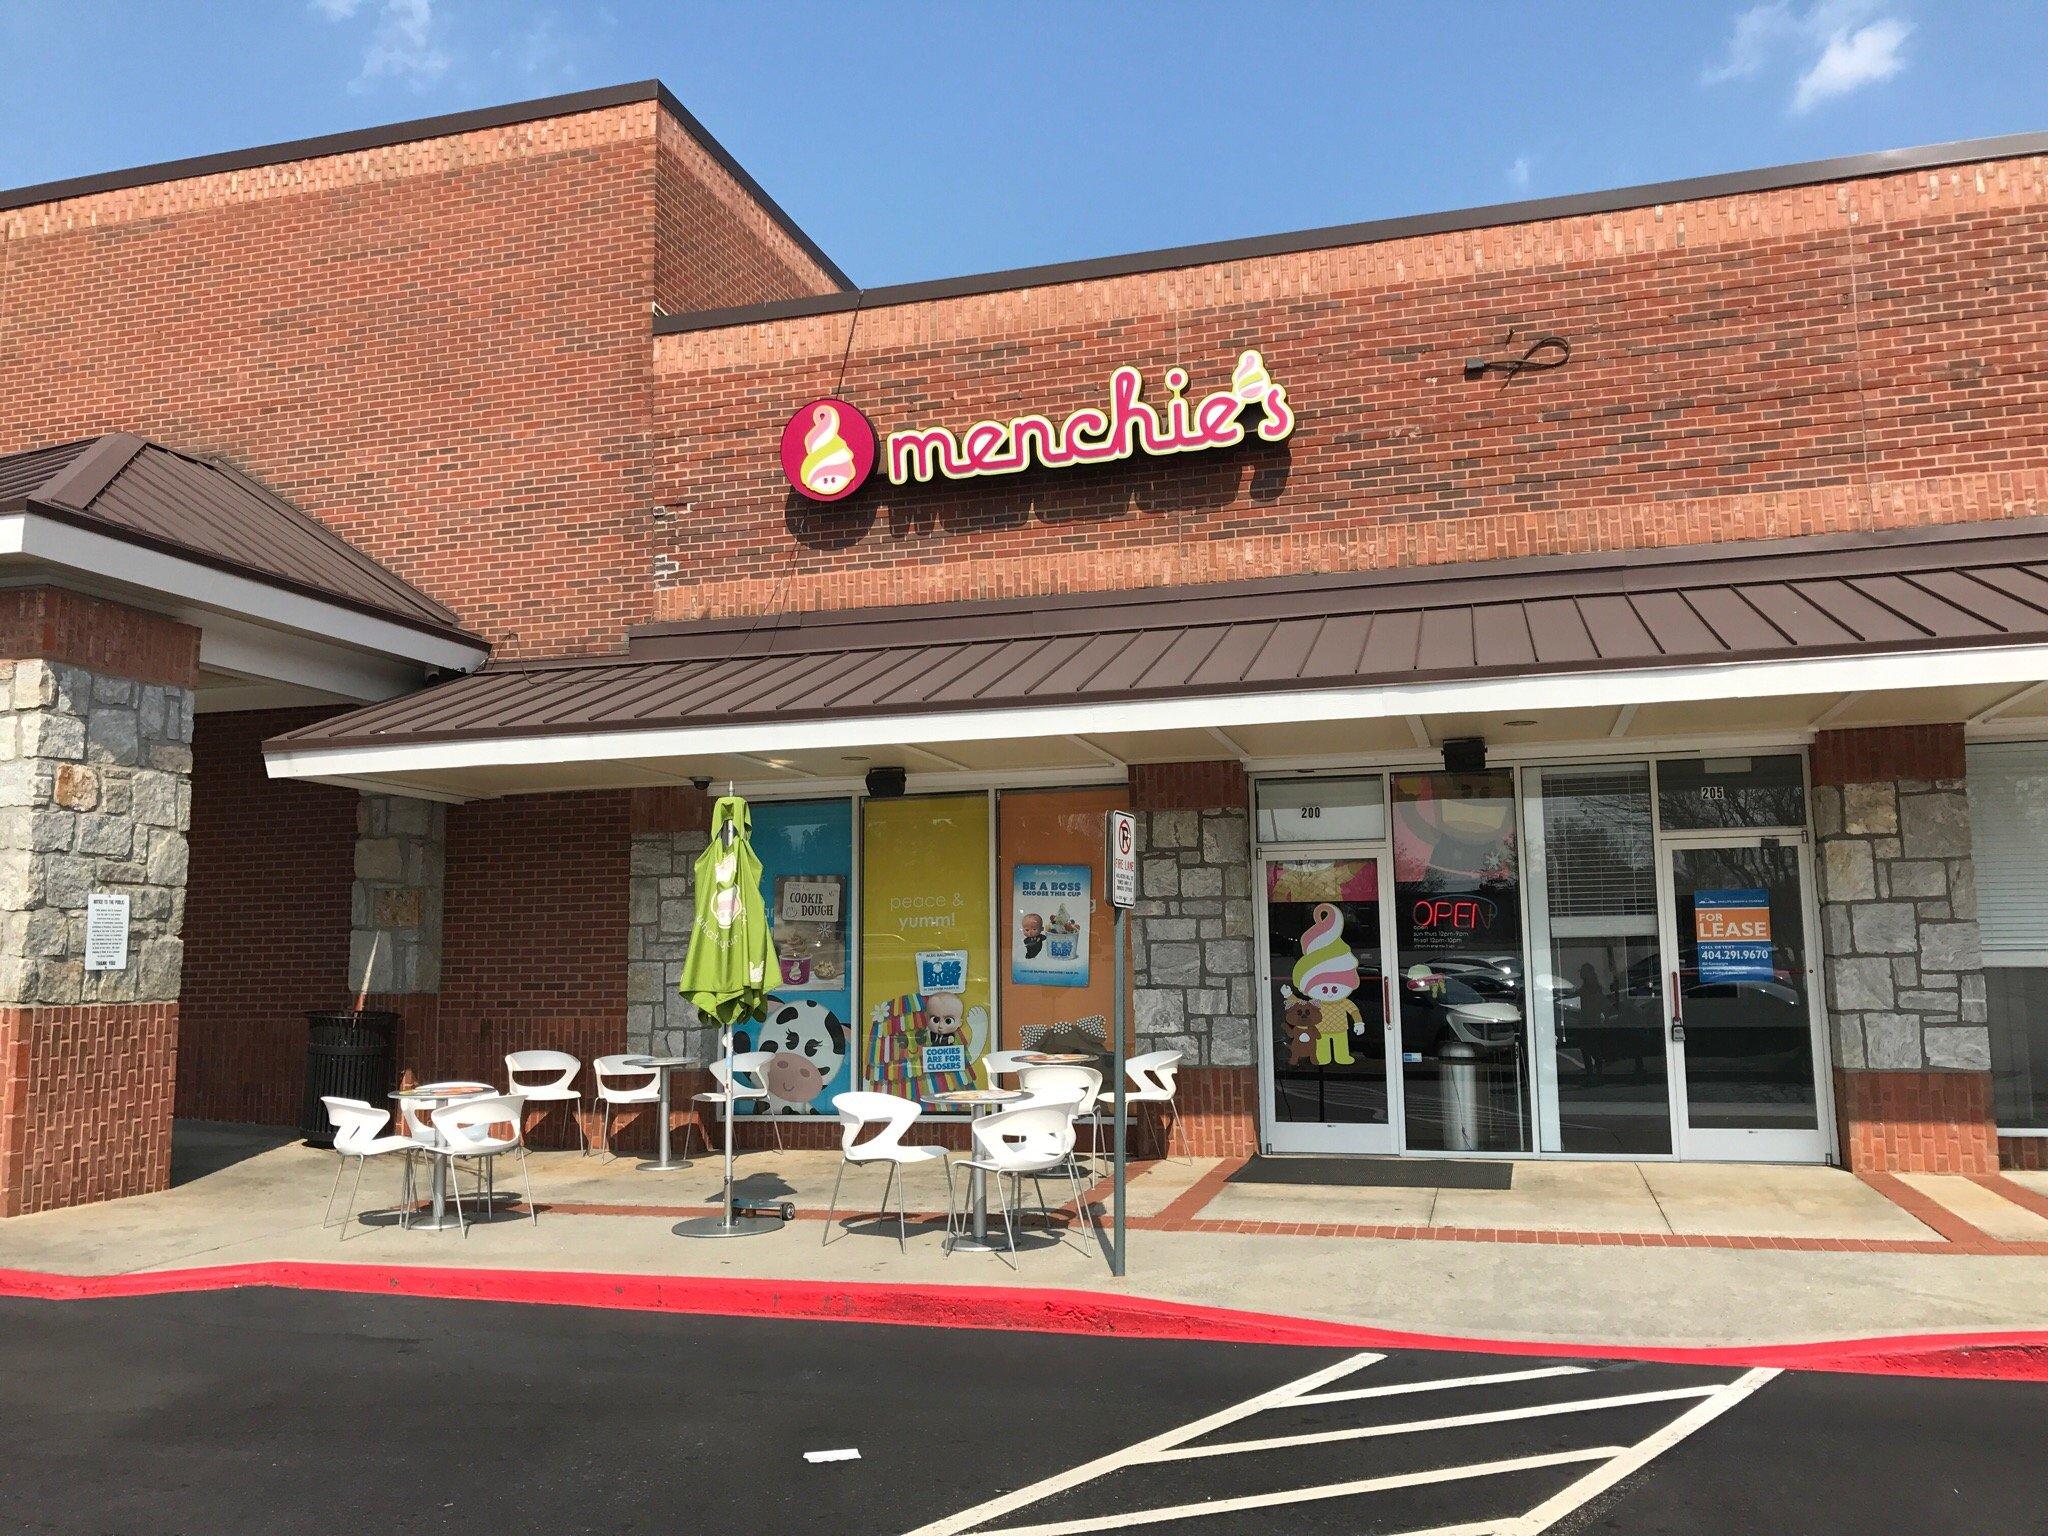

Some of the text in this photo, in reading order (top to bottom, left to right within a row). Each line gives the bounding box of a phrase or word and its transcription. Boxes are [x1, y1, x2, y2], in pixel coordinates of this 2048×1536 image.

[886, 350, 1295, 485] menchie's
[1702, 787, 1723, 799] 205
[1301, 807, 1320, 818] 200
[1115, 858, 1134, 872] FIRE LANE
[1022, 881, 1081, 891] BE A BOSS
[790, 892, 824, 904] COOKIE
[890, 892, 964, 911] peace &
[801, 904, 834, 917] DOUGH
[1413, 901, 1493, 929] OPEN
[899, 912, 956, 931] yumm!
[1699, 913, 1723, 921] FOR
[1700, 921, 1767, 938] LEASE
[1702, 949, 1769, 960] 404.291.9670
[926, 1047, 960, 1056] COOKIES
[927, 1054, 961, 1063] ARE FOR
[927, 1062, 961, 1070] CLOSERS
